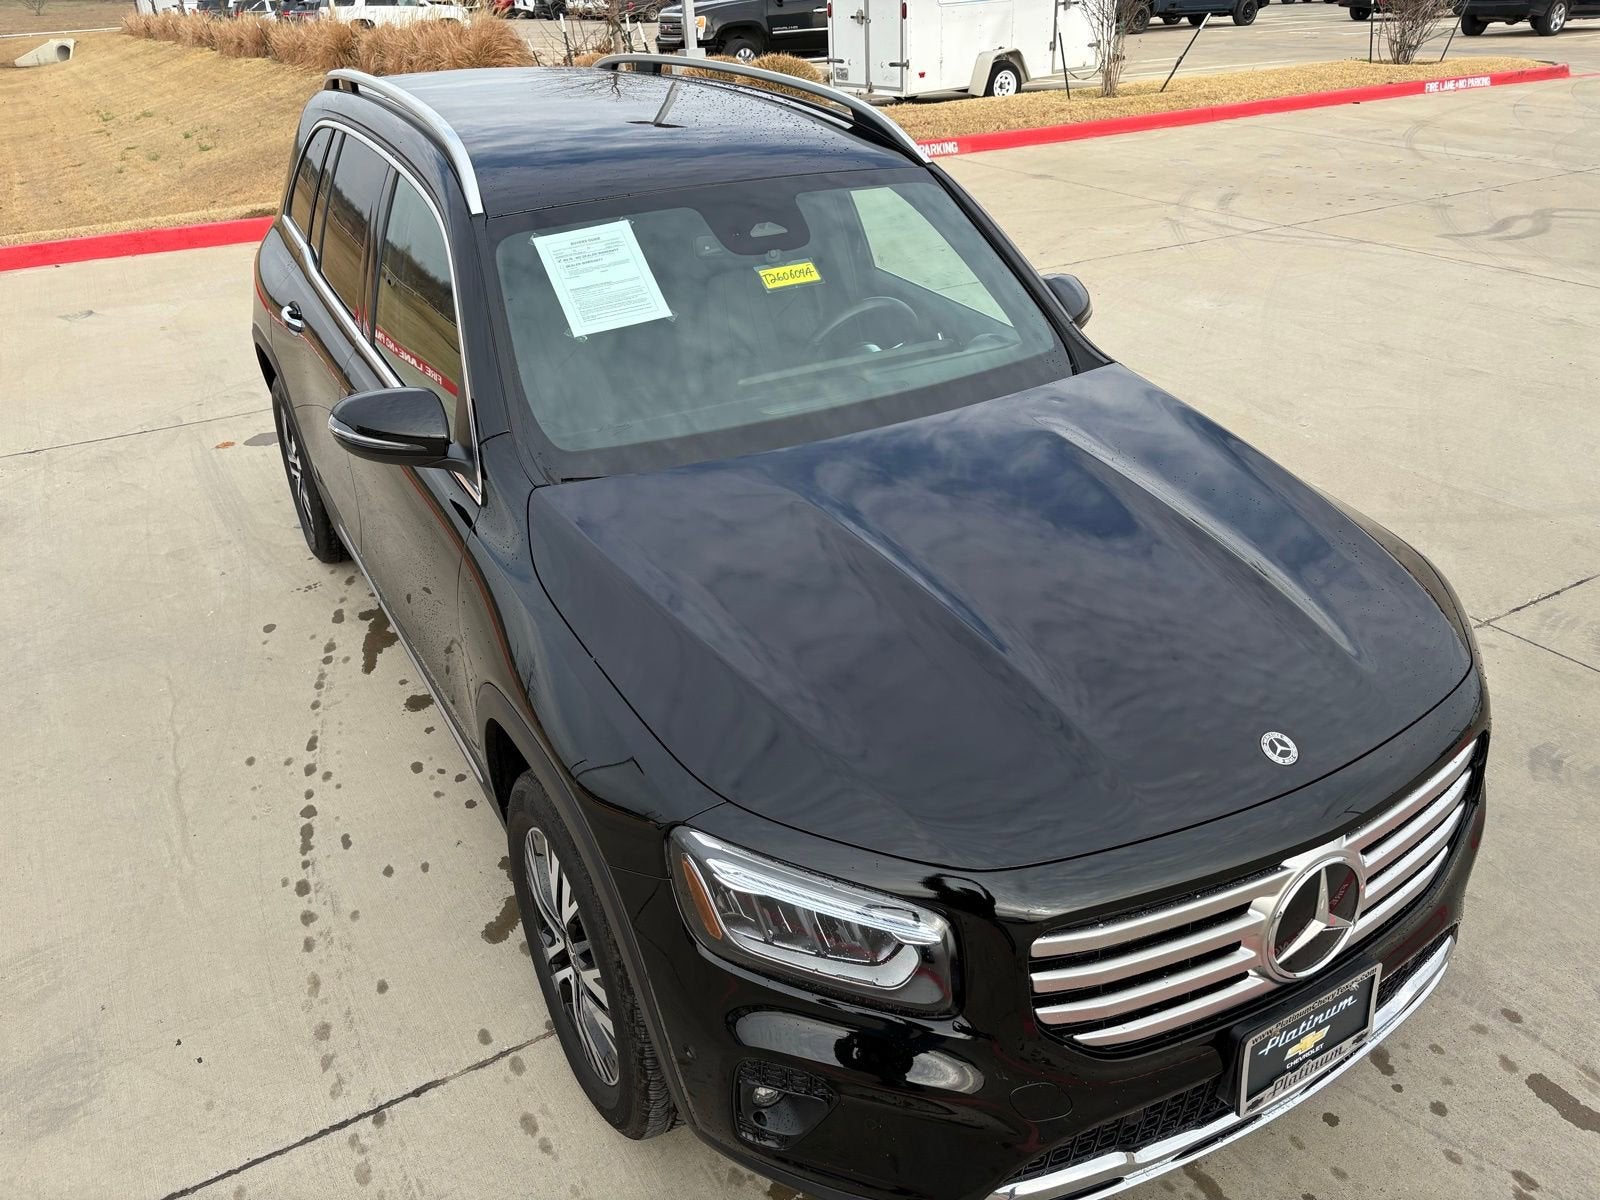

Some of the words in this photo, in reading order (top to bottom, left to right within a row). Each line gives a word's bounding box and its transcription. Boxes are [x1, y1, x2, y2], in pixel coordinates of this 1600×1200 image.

[1425, 81, 1439, 93] FIRE
[1440, 79, 1456, 92] LANE
[1458, 78, 1467, 89] NO
[1467, 76, 1491, 88] PARKING
[918, 141, 959, 156] PARKING
[1257, 994, 1358, 1056] Platinum
[1286, 1042, 1325, 1069] CHEVROLET
[1266, 1047, 1345, 1097] Platinum
